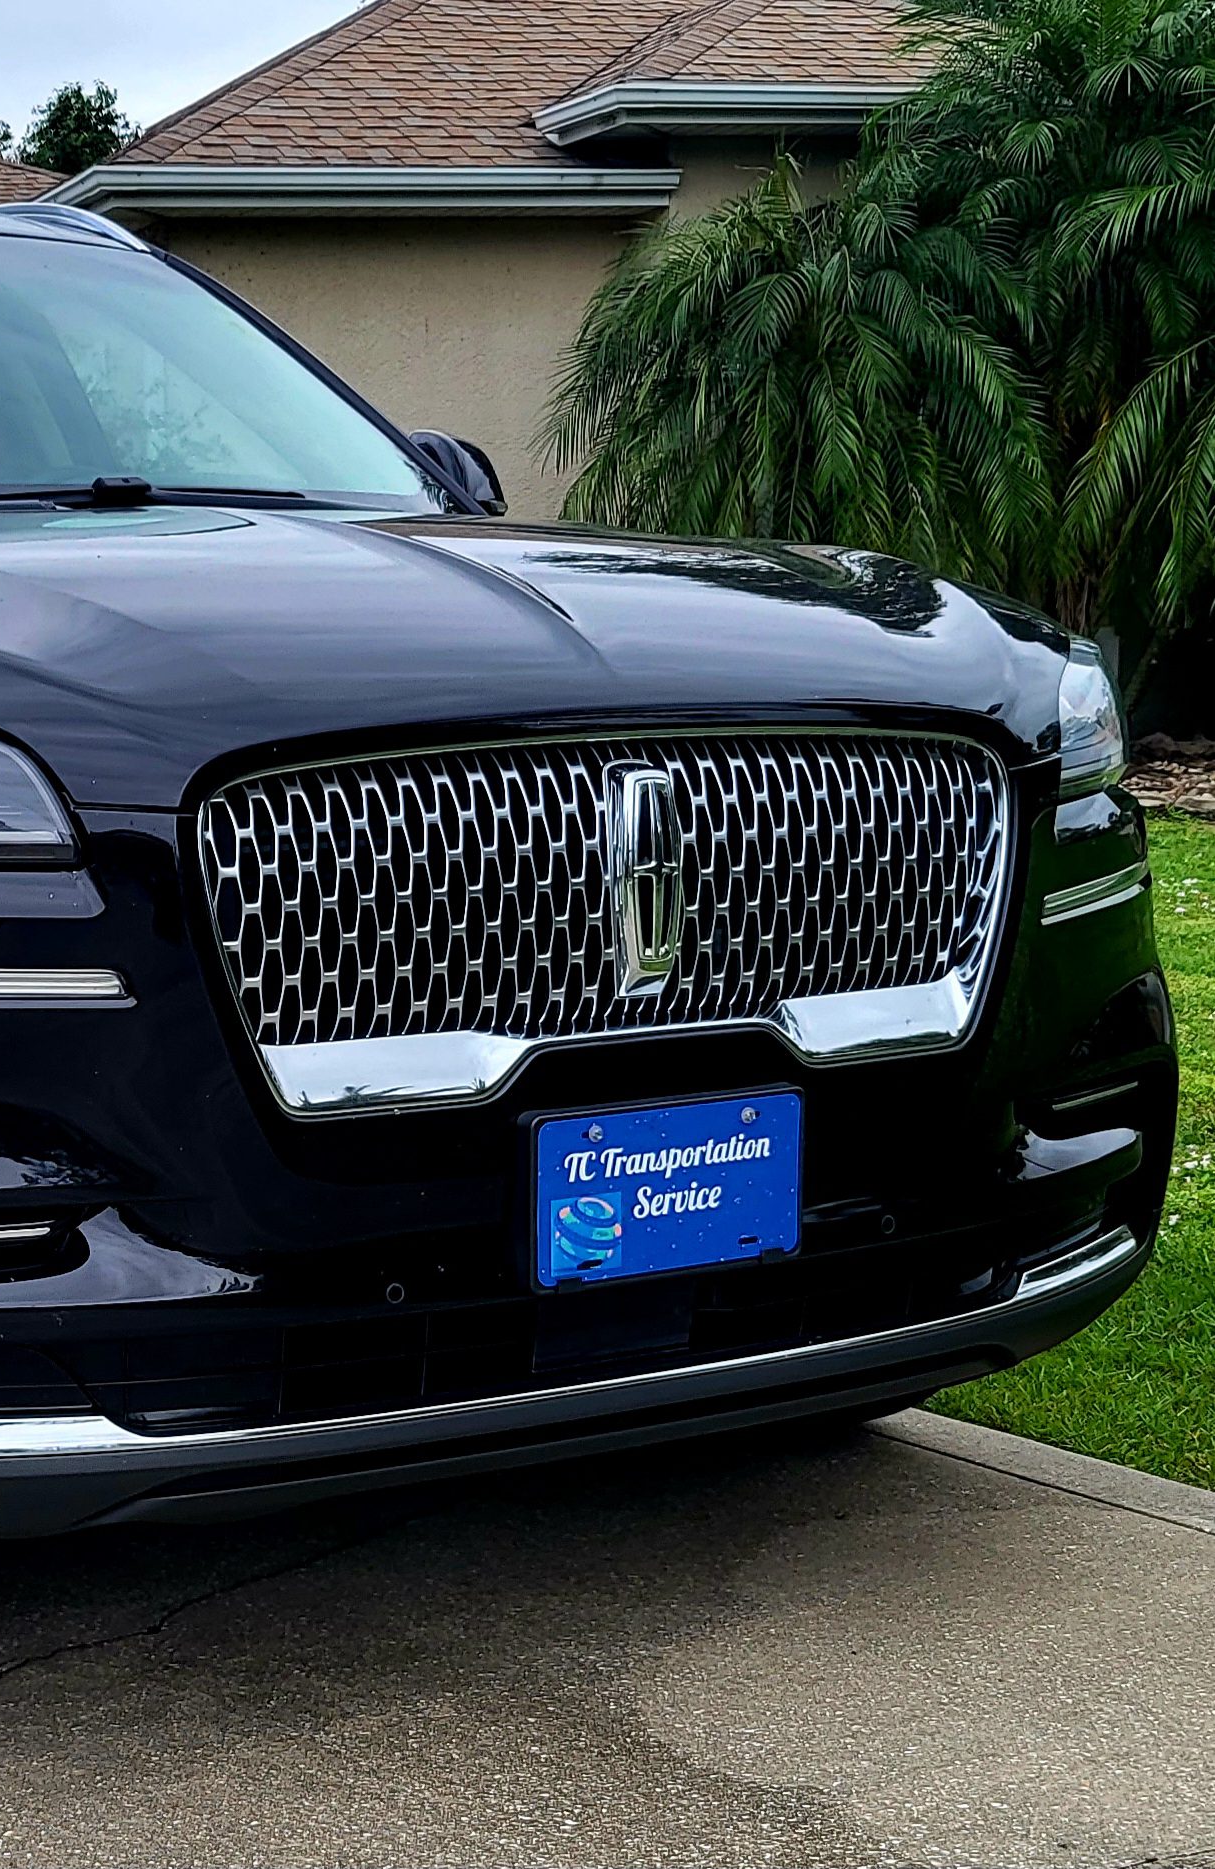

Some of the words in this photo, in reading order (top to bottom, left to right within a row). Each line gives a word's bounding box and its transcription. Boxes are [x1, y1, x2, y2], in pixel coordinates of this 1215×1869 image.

[563, 1150, 597, 1184] TC
[600, 1133, 771, 1179] Transportation
[633, 1181, 722, 1220] Service
